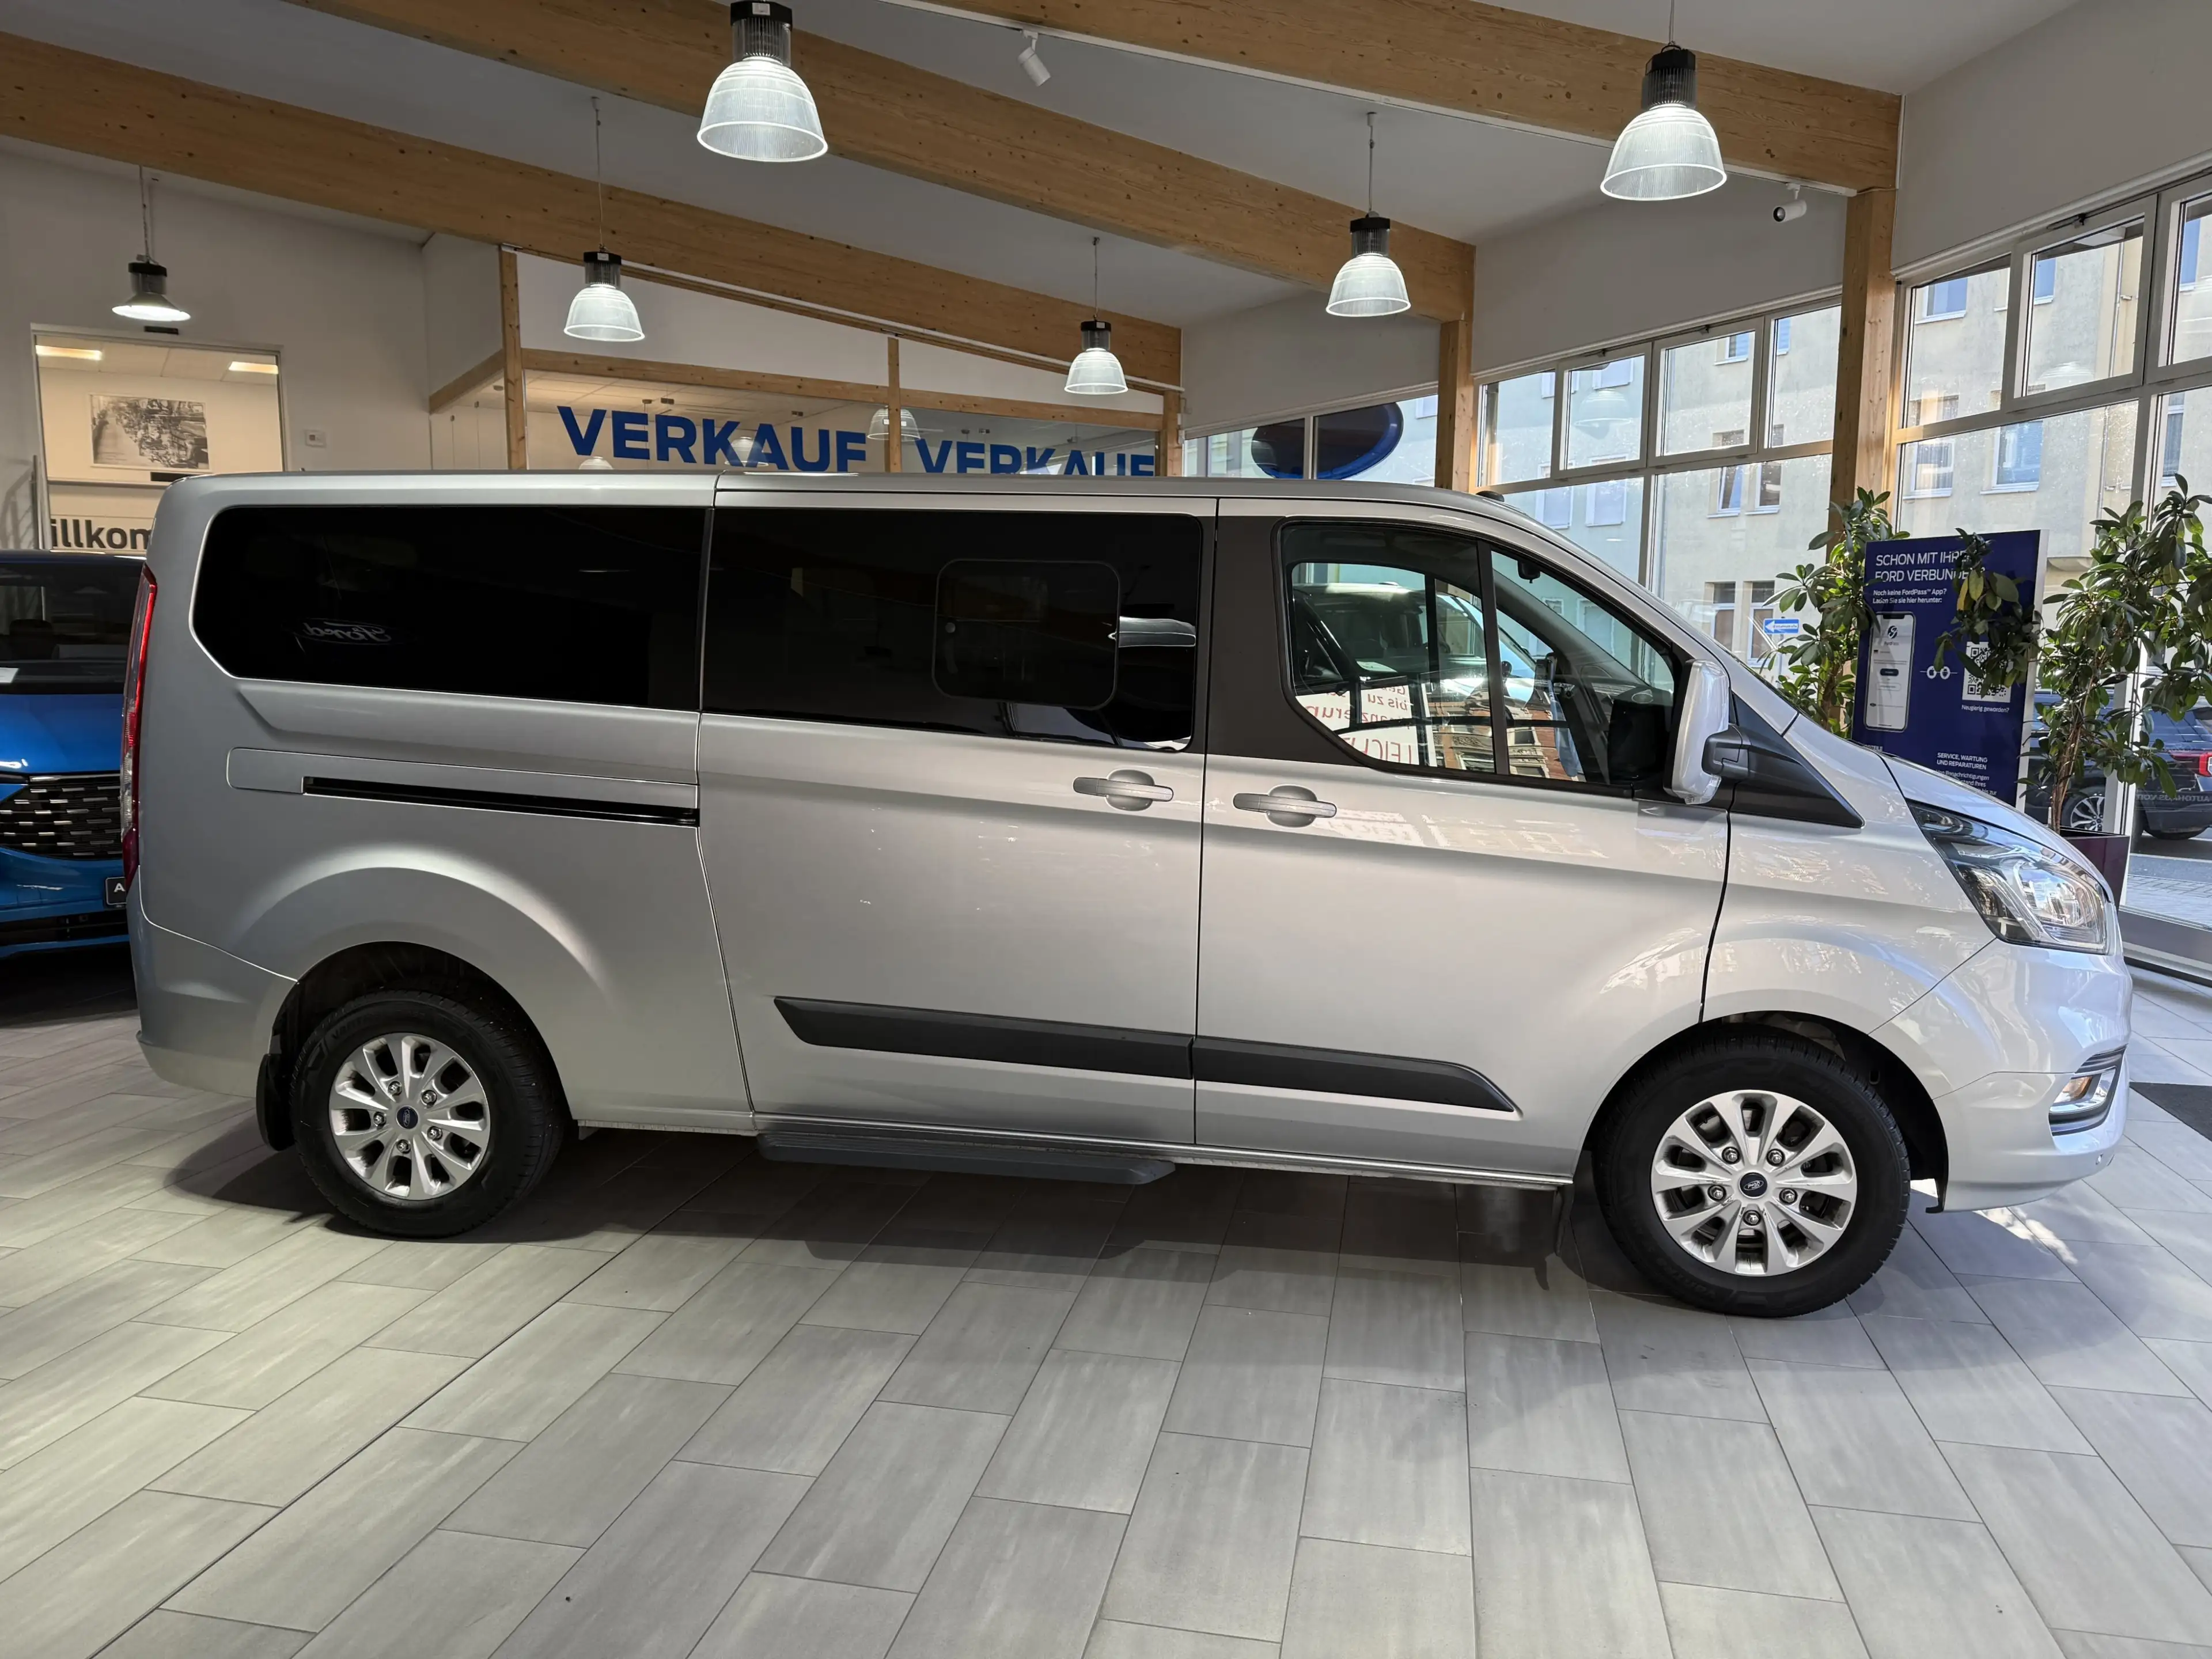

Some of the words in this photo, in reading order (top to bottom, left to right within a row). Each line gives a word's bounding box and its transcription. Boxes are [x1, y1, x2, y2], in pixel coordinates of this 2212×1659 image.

[557, 406, 867, 472] VERKAUF
[915, 438, 1154, 476] VERKAUF
[1876, 553, 1915, 566] SCHON
[1917, 552, 1938, 565] MIT
[1875, 570, 1904, 582] FORD
[1937, 752, 1960, 760] SERVICE,
[1961, 755, 1987, 763] WARTUNG
[1948, 760, 1987, 770] REPARATUREN
